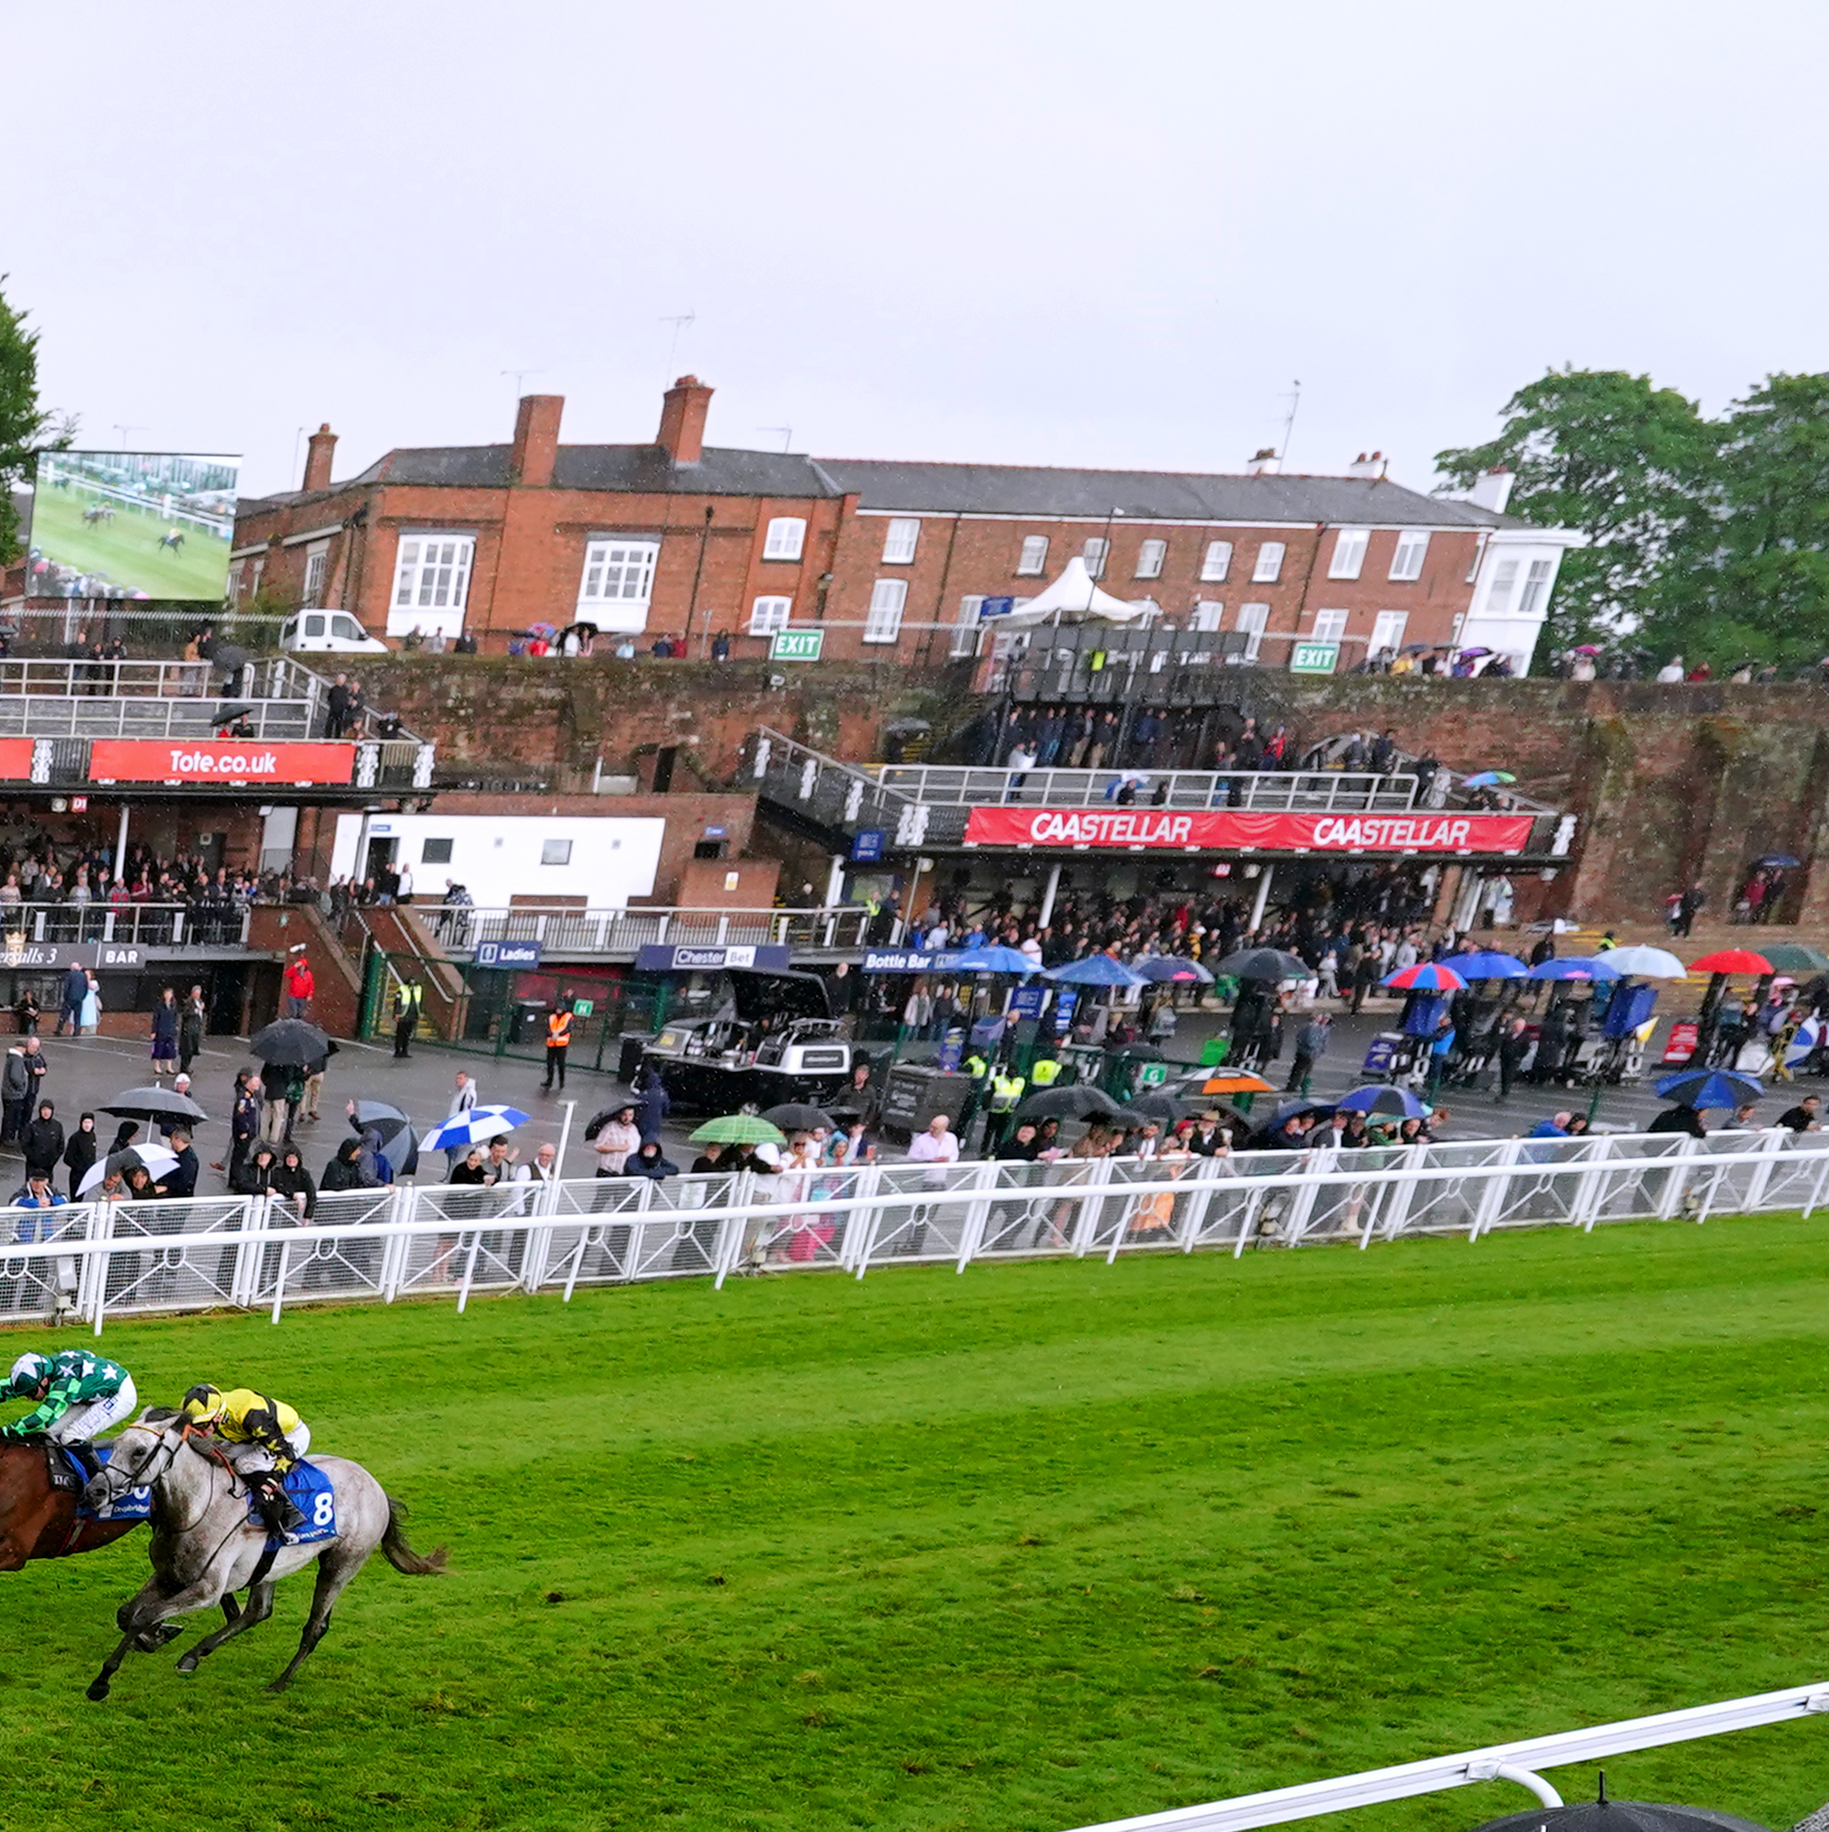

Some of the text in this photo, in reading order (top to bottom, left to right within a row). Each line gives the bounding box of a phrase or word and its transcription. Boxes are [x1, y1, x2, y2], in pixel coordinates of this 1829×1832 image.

[776, 635, 819, 655] EXIT
[1296, 648, 1336, 667] EXIT
[169, 749, 277, 775] Tote.co.uk
[1031, 813, 1193, 842] CAASTELLAR
[1313, 818, 1471, 847] CAASTELLAR
[46, 948, 58, 963] 3
[105, 949, 139, 964] BAR
[499, 948, 536, 962] Ladies
[675, 948, 751, 964] Chester Bet
[865, 953, 932, 970] Bottle Bar
[578, 1003, 588, 1014] H
[1148, 1067, 1160, 1081] G
[313, 1492, 334, 1527] 8
